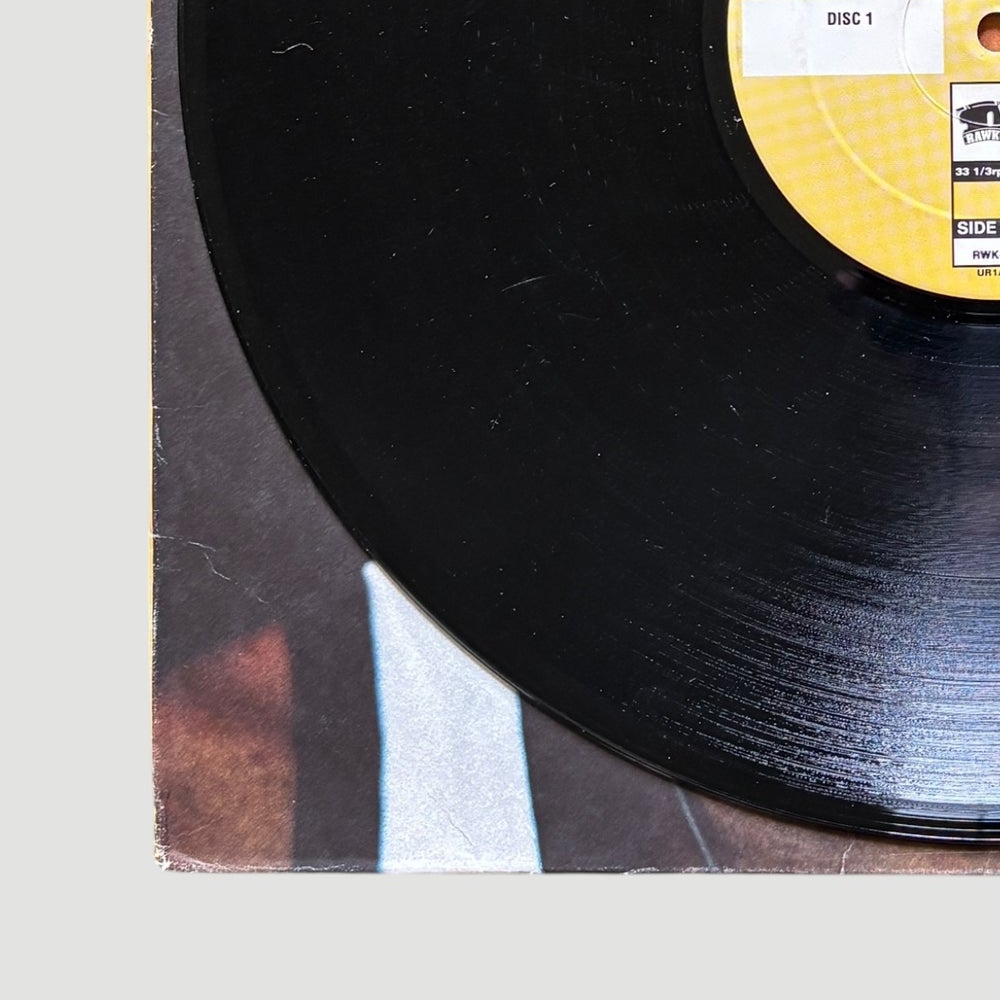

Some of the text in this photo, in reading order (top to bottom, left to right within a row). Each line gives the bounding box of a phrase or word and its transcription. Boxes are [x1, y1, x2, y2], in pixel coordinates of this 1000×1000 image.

[827, 11, 873, 26] DISC 1
[955, 167, 970, 176] 33
[957, 221, 997, 235] SIDE
